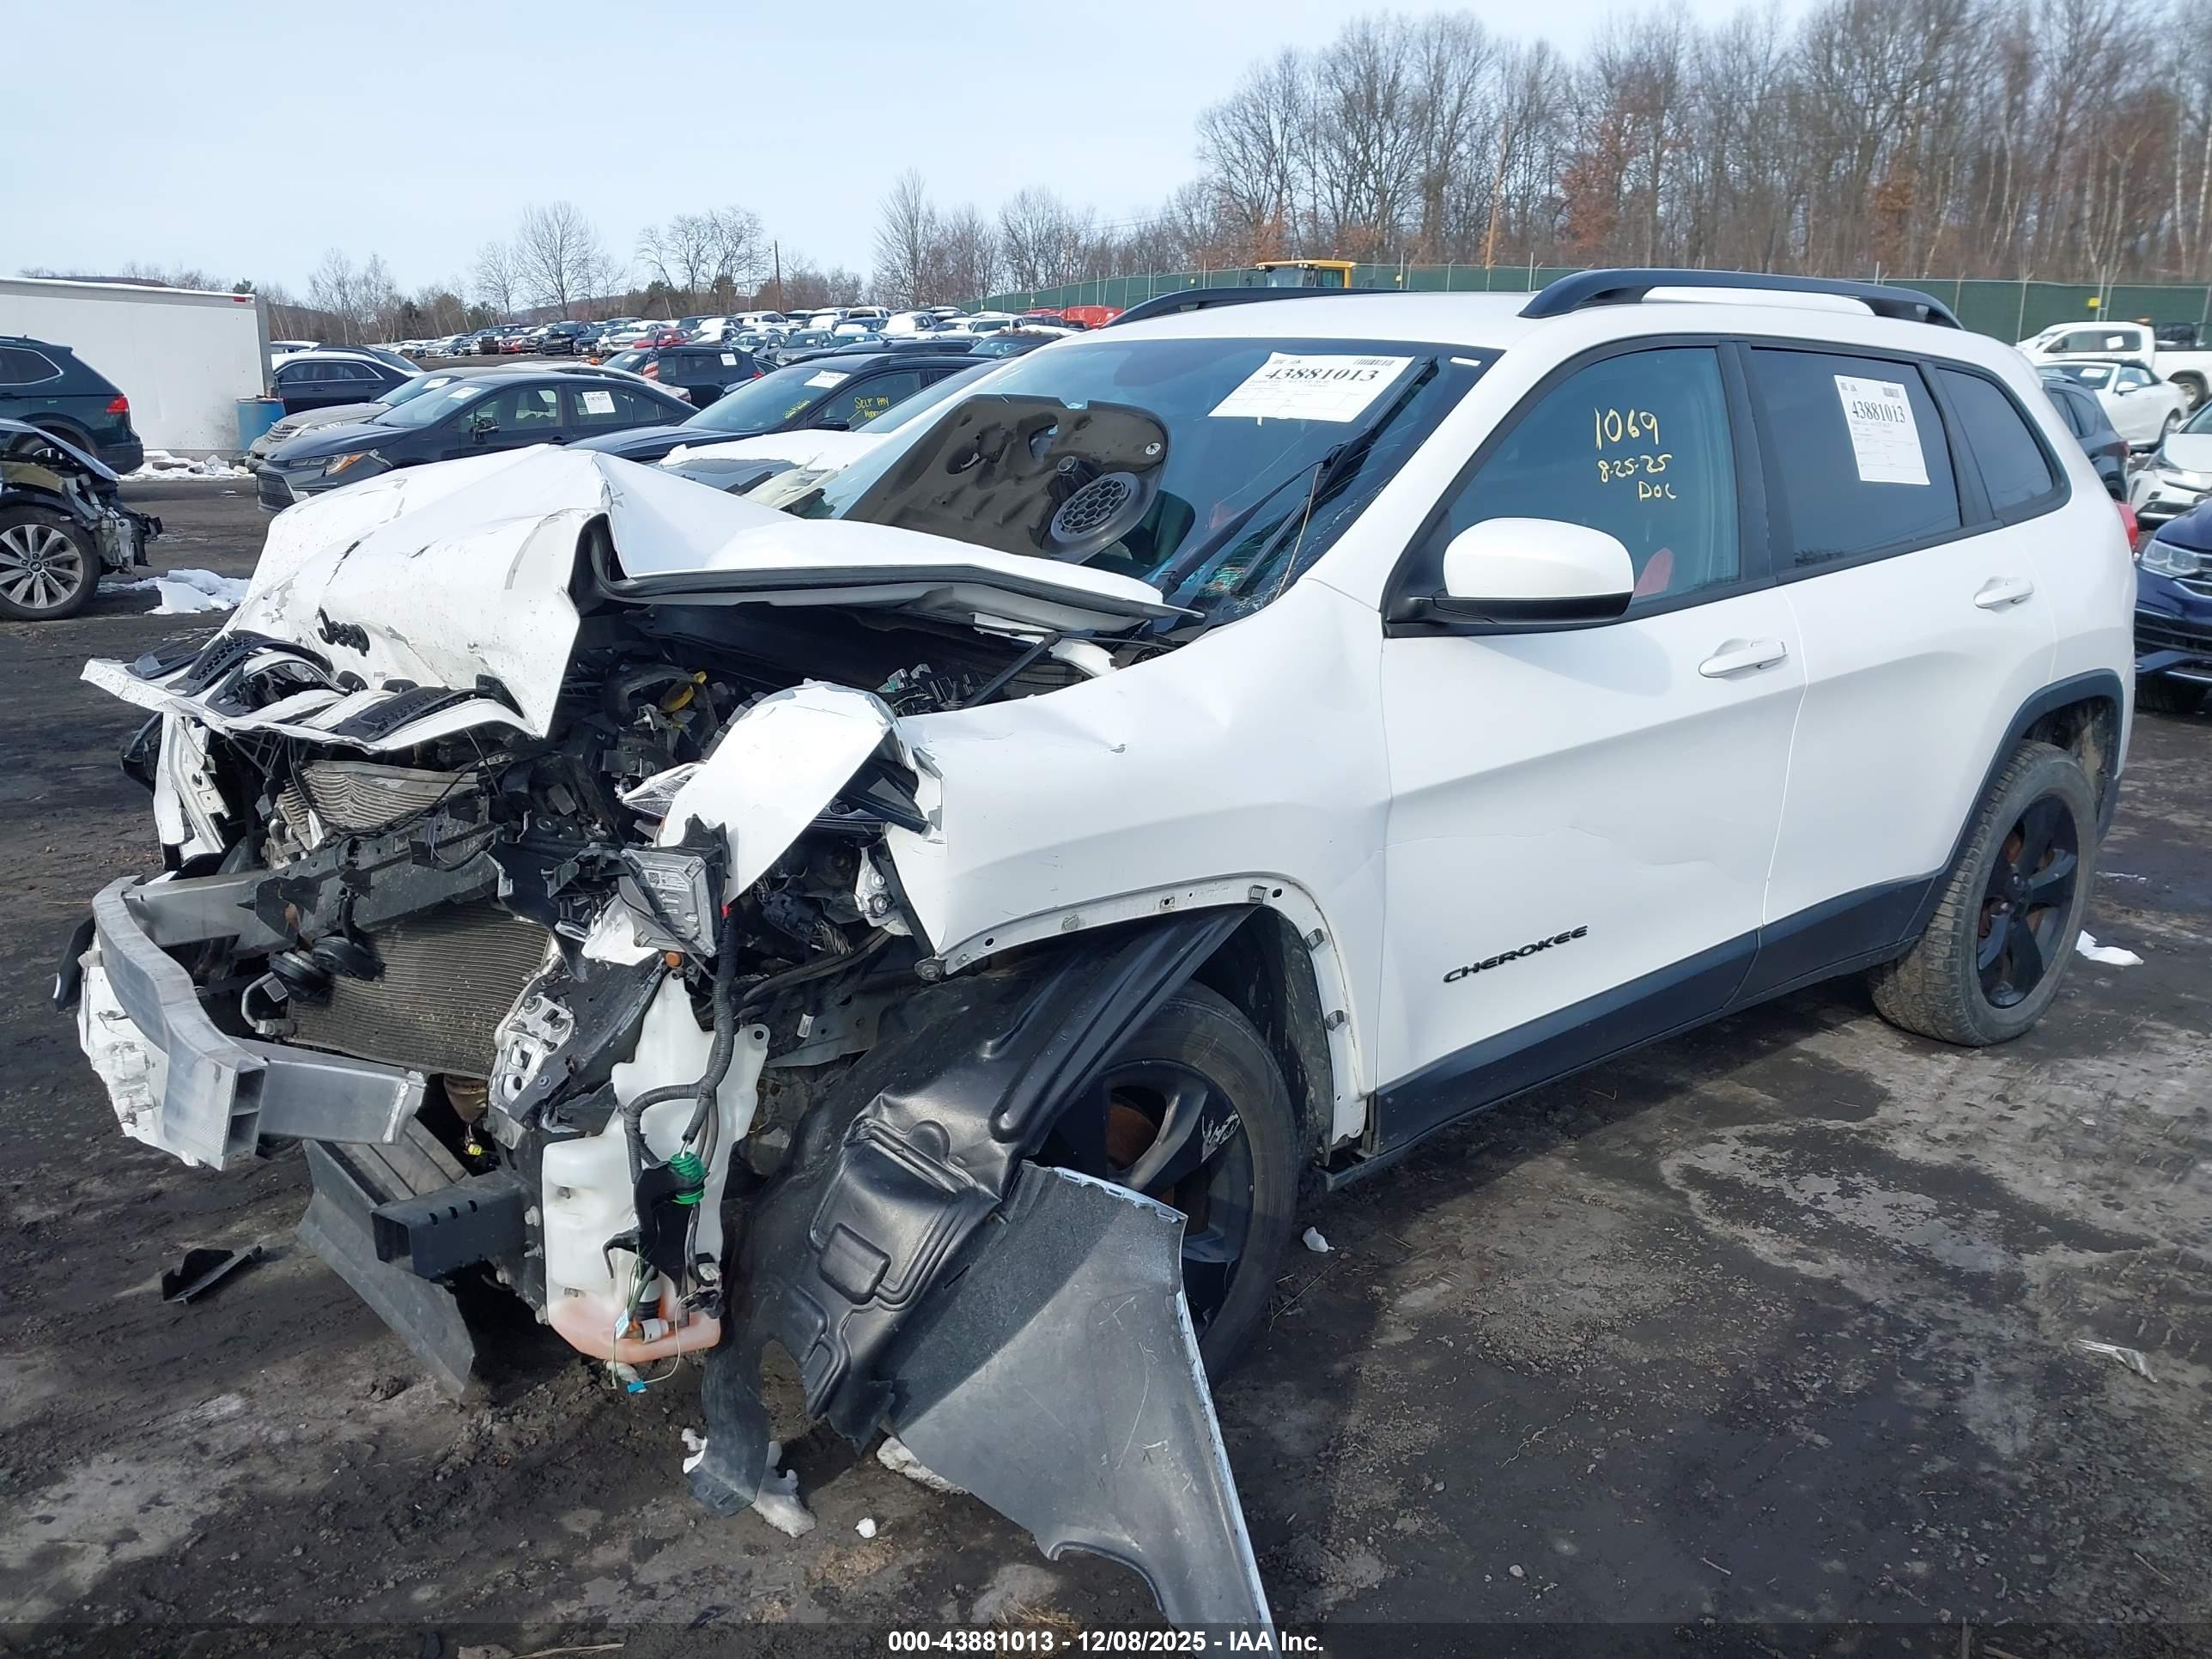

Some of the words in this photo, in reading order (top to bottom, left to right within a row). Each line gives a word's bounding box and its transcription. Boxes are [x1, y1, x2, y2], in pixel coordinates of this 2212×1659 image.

[1266, 368, 1379, 381] 43881013
[854, 397, 873, 409] SELF
[876, 396, 890, 407] PAY
[1850, 400, 1906, 423] 43881013
[1594, 406, 1659, 451] 1069
[1638, 481, 1677, 501] DOC
[316, 605, 370, 658] Jeep
[1443, 925, 1589, 983] CHEROKEE
